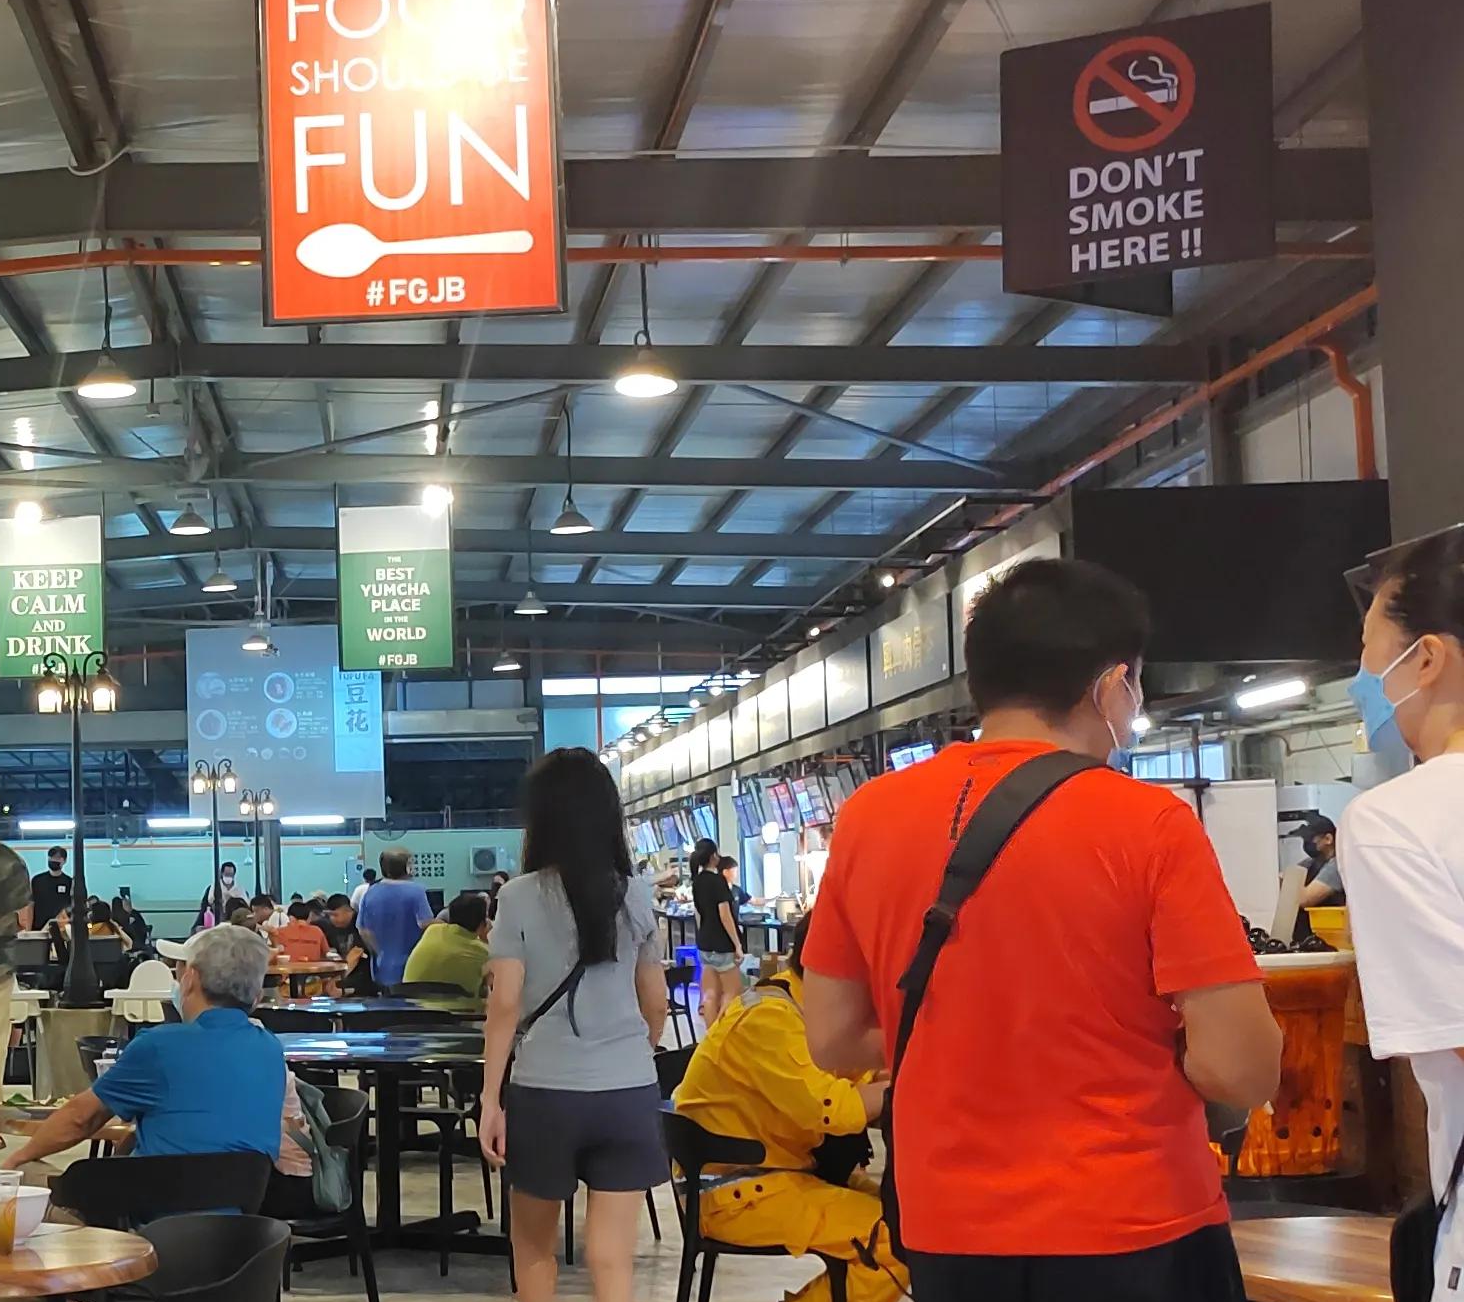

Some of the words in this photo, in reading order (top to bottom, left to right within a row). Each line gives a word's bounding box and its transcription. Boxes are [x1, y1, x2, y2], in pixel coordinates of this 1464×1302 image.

[289, 51, 451, 97] SHOU
[293, 104, 530, 214] FUN
[1068, 148, 1204, 199] DON'T
[1068, 188, 1204, 235] SMOKE
[1071, 232, 1170, 273] HERE
[365, 277, 466, 306] #FGJB
[387, 556, 402, 564] THE
[12, 568, 84, 590] KEEP
[375, 567, 415, 581] BEST
[360, 582, 431, 598] YUMCHA
[11, 593, 87, 615] CALM
[371, 599, 422, 613] PLACE
[32, 619, 66, 633] AND
[394, 615, 408, 623] THE
[366, 626, 427, 642] WORLD
[6, 634, 93, 657] DRINK
[378, 653, 418, 666] #FGJB
[344, 682, 369, 733] 豆花
